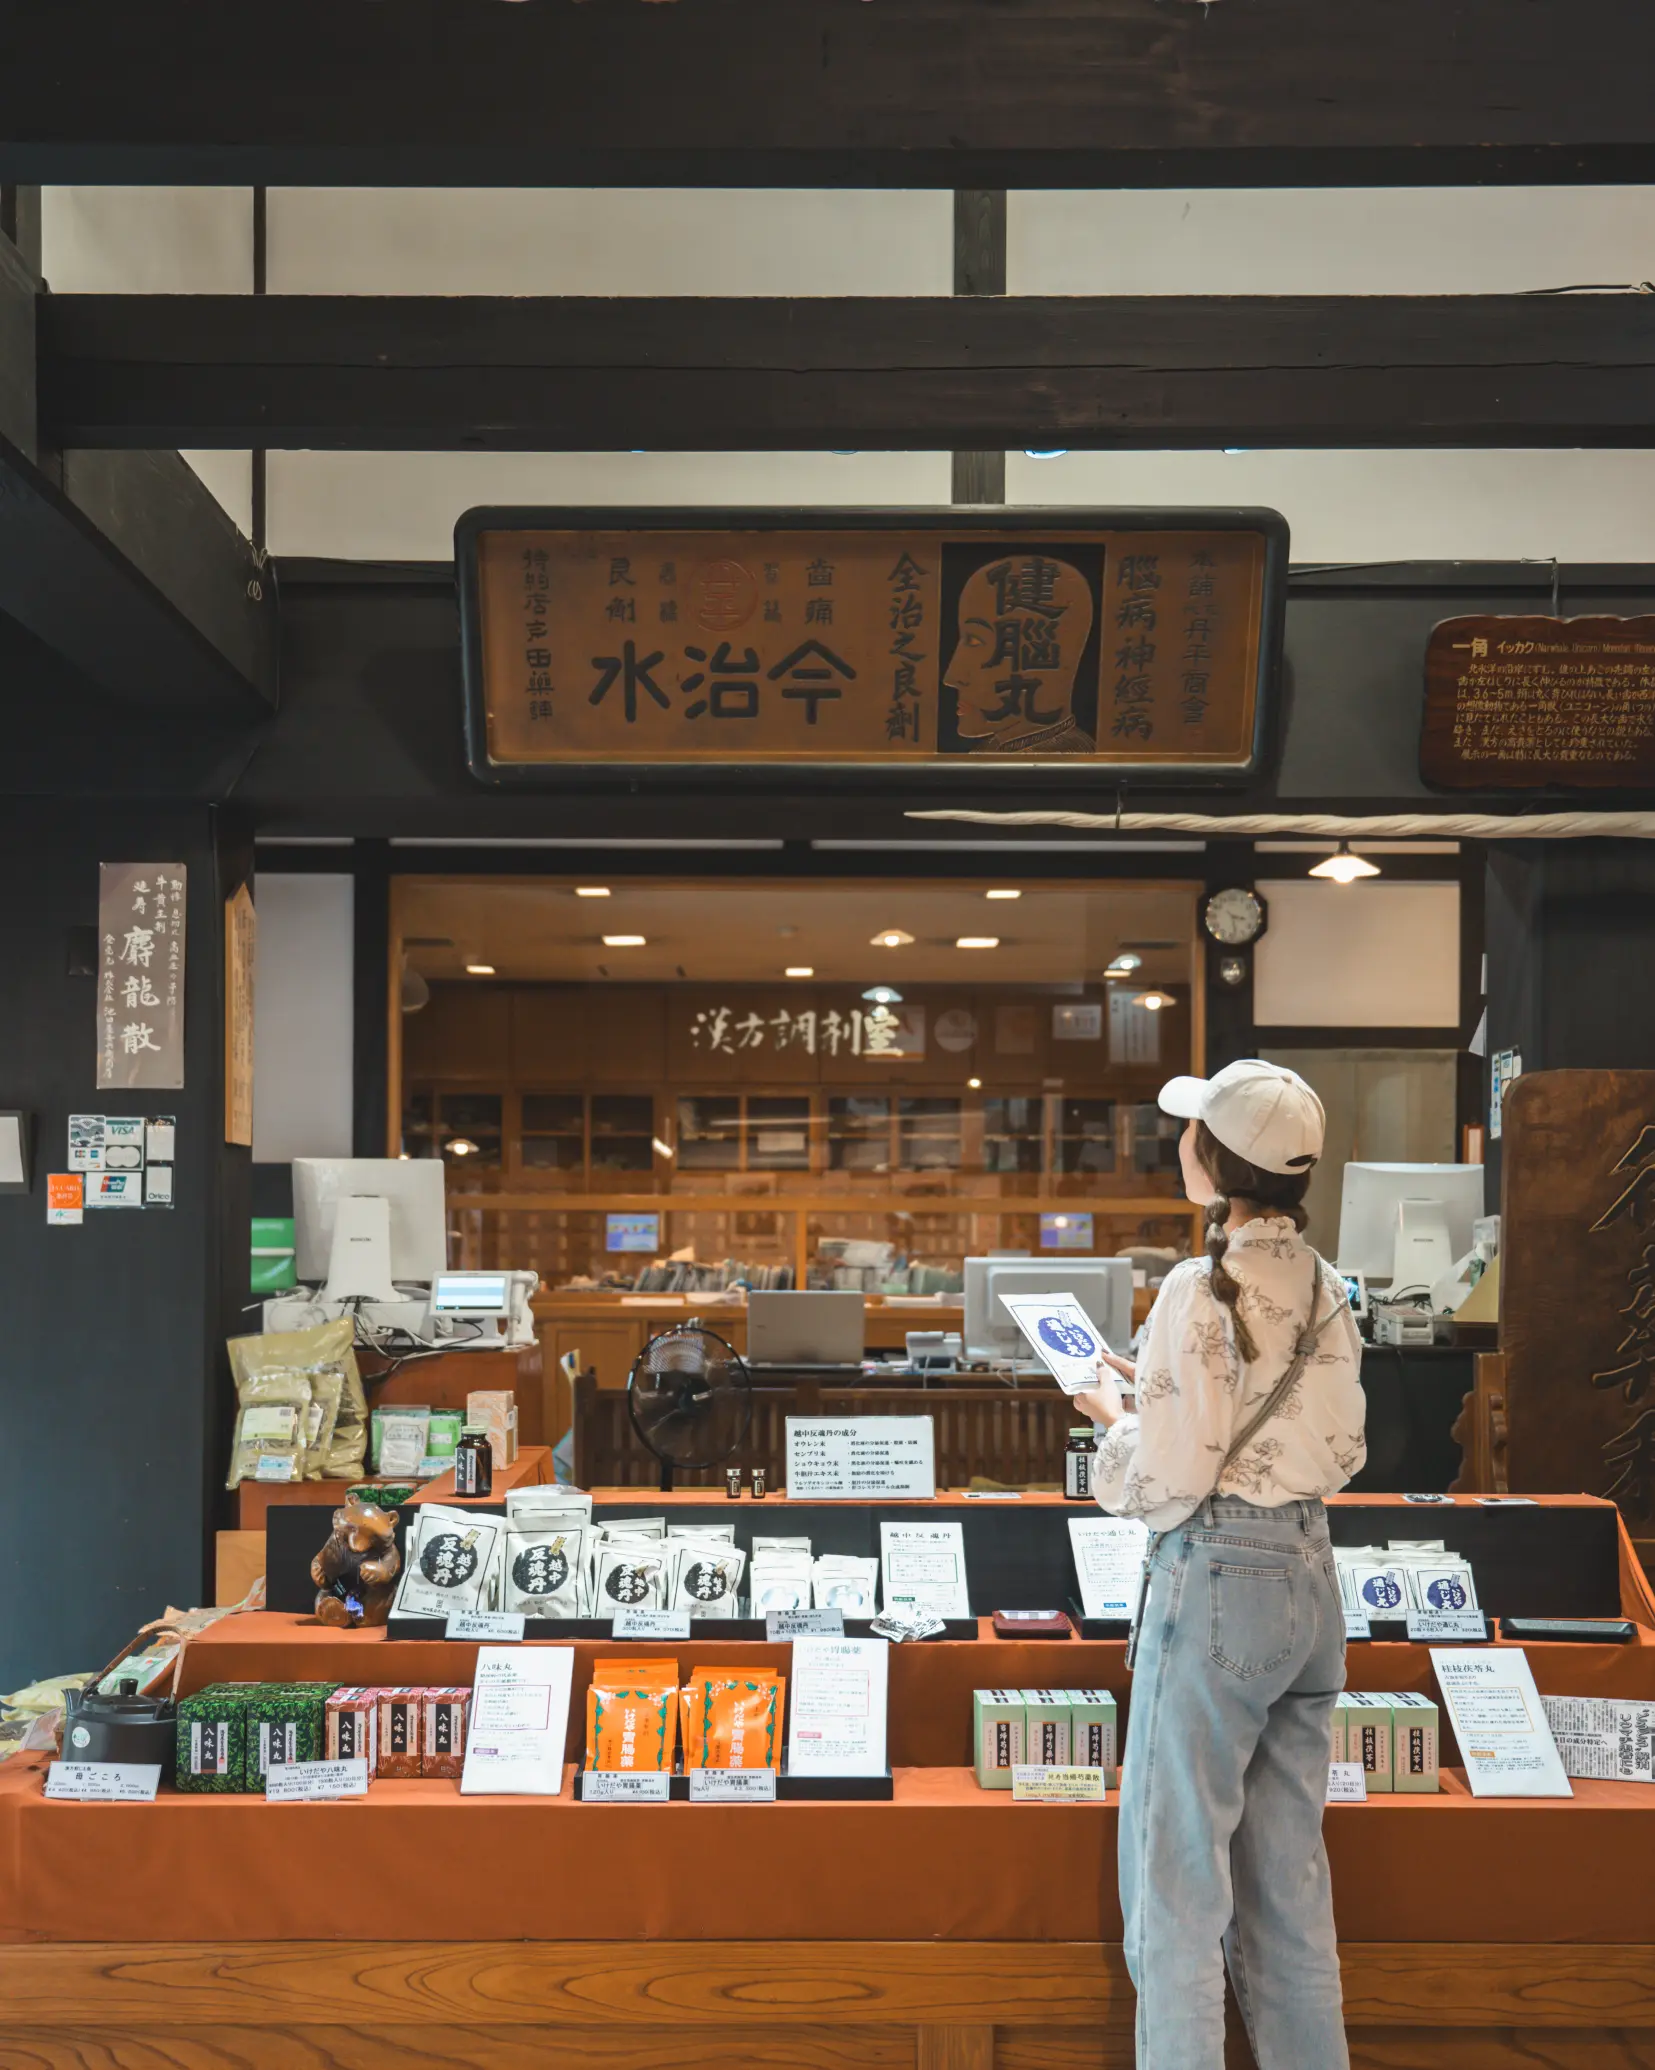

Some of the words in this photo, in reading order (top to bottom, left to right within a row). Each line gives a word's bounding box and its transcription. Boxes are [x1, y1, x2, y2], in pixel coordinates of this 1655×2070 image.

[1451, 637, 1488, 658] 一角
[1496, 640, 1535, 654] イッカク
[587, 639, 858, 726] 今治水
[690, 1006, 905, 1057] 漢方調剤室
[111, 1125, 135, 1136] VISA
[148, 1192, 171, 1200] Orico
[793, 1429, 858, 1438] 越中反魂丹の成分
[1077, 1456, 1088, 1494] 桂枝茯苓丸
[432, 1536, 459, 1585] 反魂丹
[454, 1553, 473, 1580] 越中
[527, 1547, 548, 1592] 反魂丹
[548, 1559, 564, 1585] 越中
[1372, 1577, 1390, 1608] 通じ丸
[459, 1621, 490, 1629] 越中反魂丹
[480, 1662, 513, 1671] 八味丸
[1441, 1664, 1496, 1673] 桂枝茯苓丸
[341, 1720, 353, 1753] 八味丸
[393, 1712, 405, 1744] 八味丸
[437, 1712, 449, 1744] 八味丸
[203, 1727, 215, 1760] 八味丸
[272, 1727, 284, 1761] 八味丸
[1364, 1727, 1375, 1770] 桂枝茯苓丸
[1412, 1728, 1422, 1772] 桂枝茯苓丸
[75, 1772, 122, 1781] 母ごころ
[299, 1765, 348, 1775] いけだや八味丸
[704, 1778, 749, 1786] いけだや胃腸薬
[597, 1781, 641, 1789] いけだや胃腸薬
